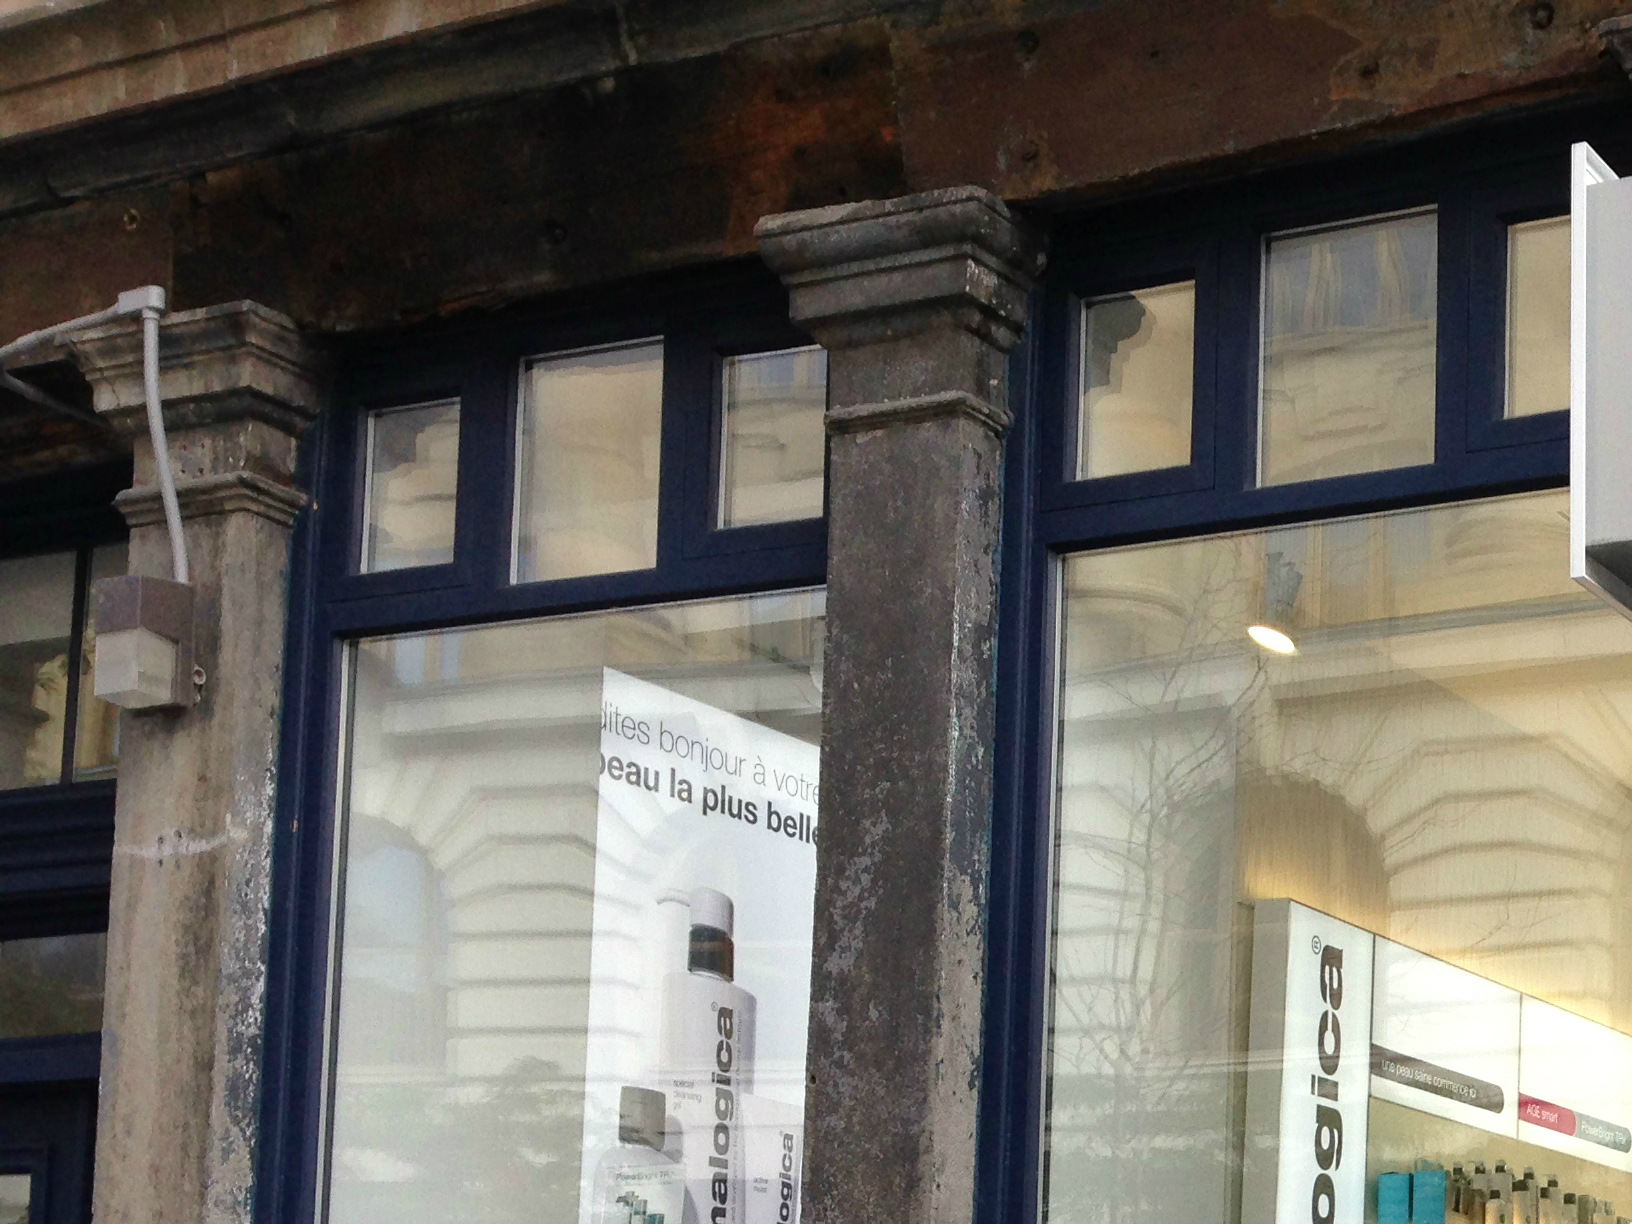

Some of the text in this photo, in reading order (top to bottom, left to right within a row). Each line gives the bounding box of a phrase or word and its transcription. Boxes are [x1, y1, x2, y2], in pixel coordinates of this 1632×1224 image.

[660, 721, 746, 777] bonjour
[753, 756, 766, 787] à
[670, 768, 693, 804] la
[702, 785, 758, 825] plus
[1396, 1064, 1413, 1078] peau
[1415, 1069, 1432, 1085] saine
